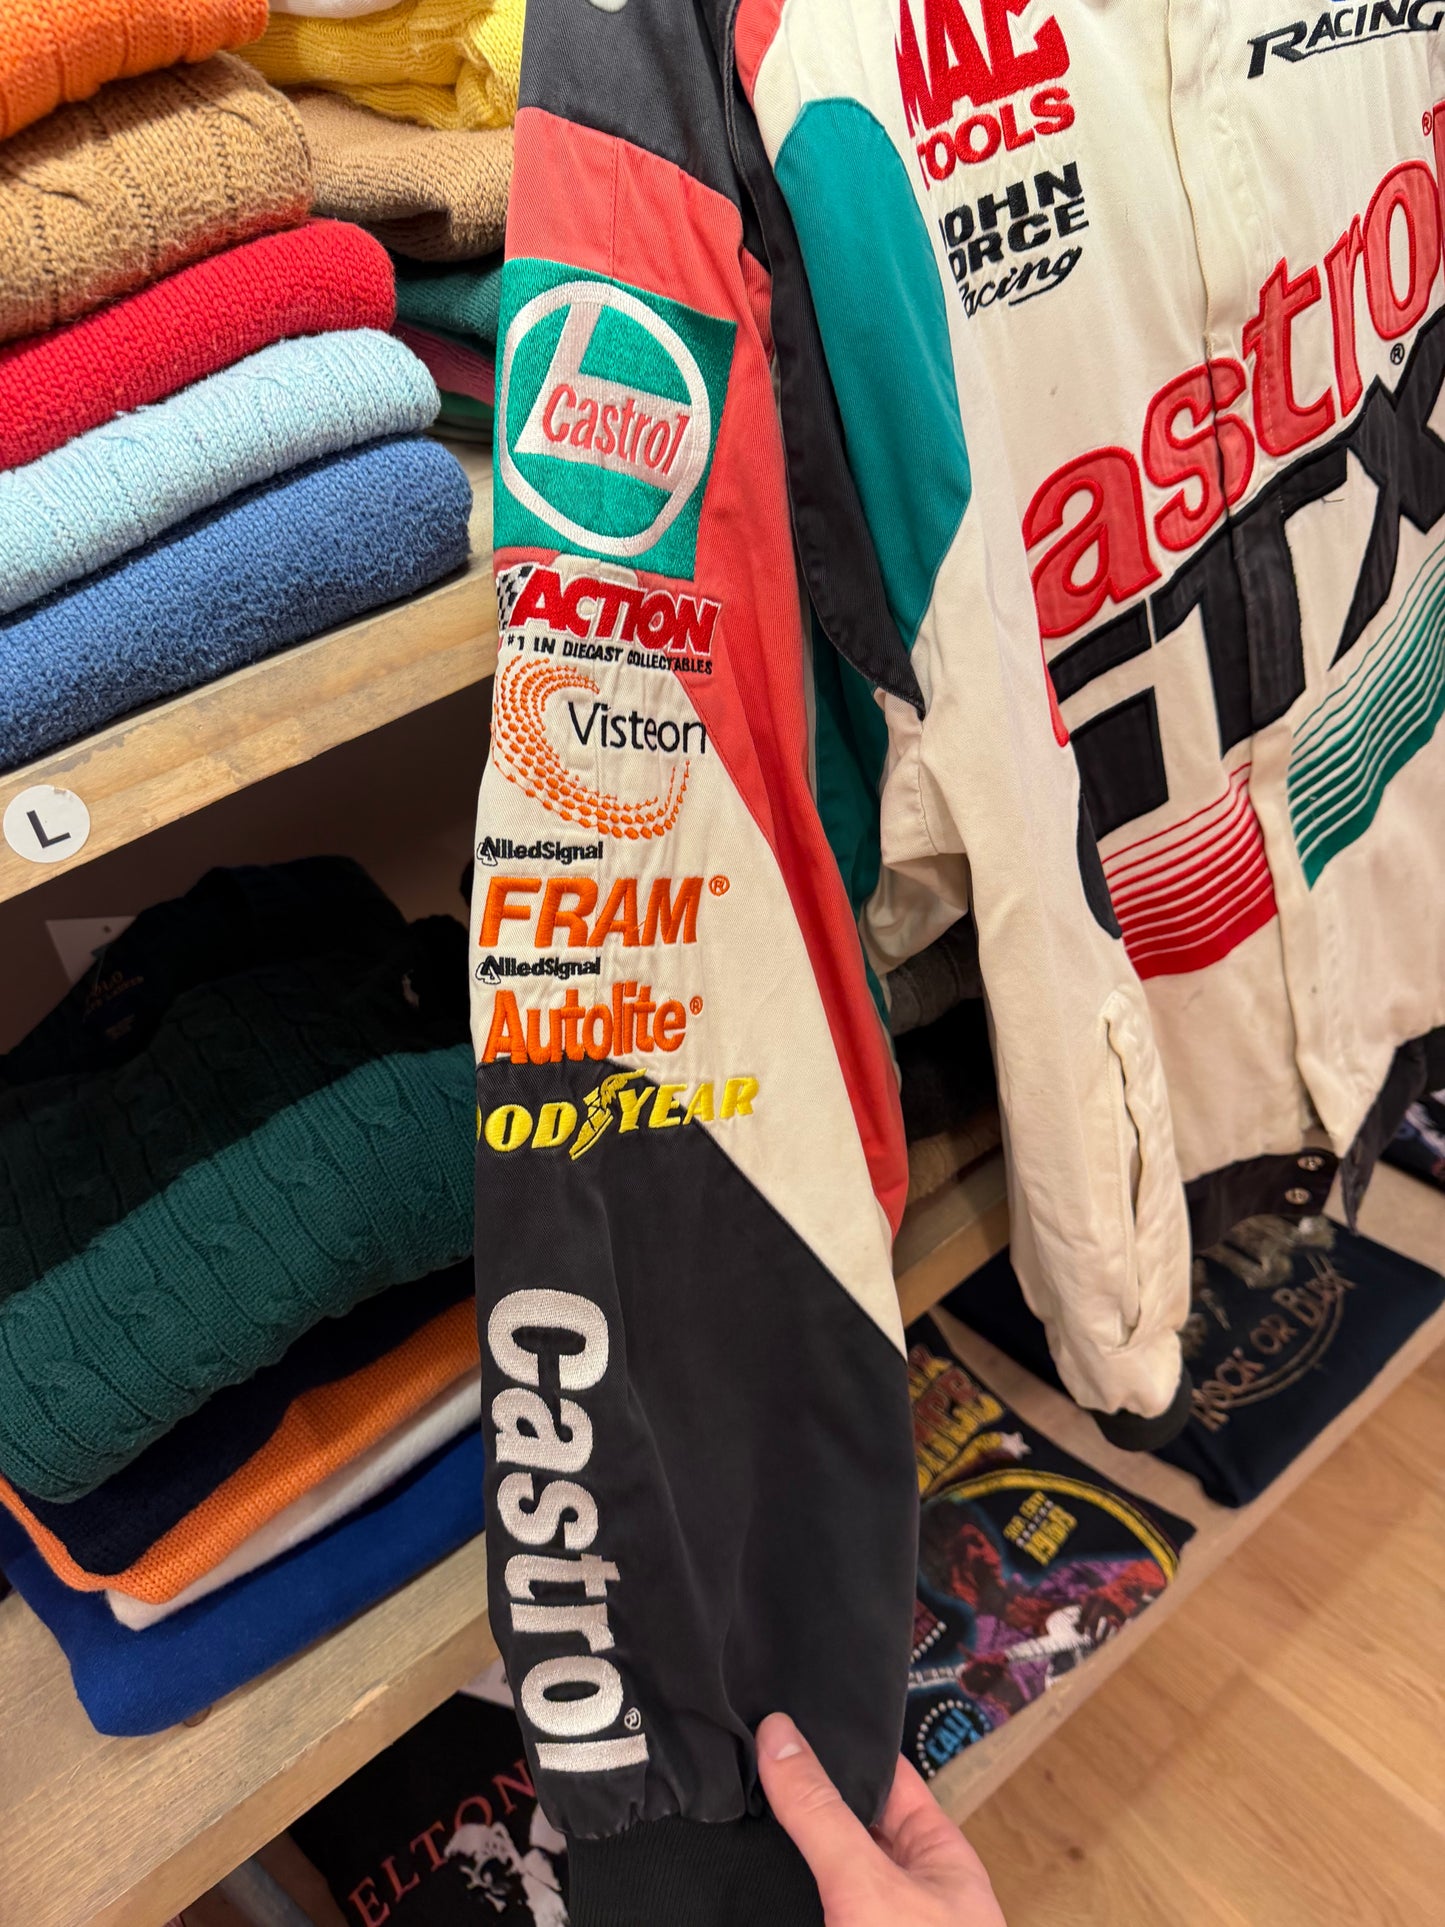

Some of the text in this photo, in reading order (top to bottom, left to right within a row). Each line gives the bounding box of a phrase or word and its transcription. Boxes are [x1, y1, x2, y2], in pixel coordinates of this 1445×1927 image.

[1247, 0, 1445, 79] RACING
[938, 160, 1083, 254] OHN
[948, 196, 1090, 284] ORCE
[959, 246, 1083, 320] acing
[1022, 102, 1445, 640] astro
[541, 383, 694, 475] Castrol
[508, 566, 722, 656] ACTION
[507, 633, 714, 676] #1 IN DIECAST COLLECTABLES
[567, 701, 707, 755] Visteon
[26, 809, 72, 849] L
[476, 836, 604, 866] AlliedSignal
[475, 955, 601, 985] AlliedSignal
[1249, 1313, 1299, 1356] OR
[487, 1288, 650, 1773] Castrol
[348, 1757, 537, 1927] ELTON
